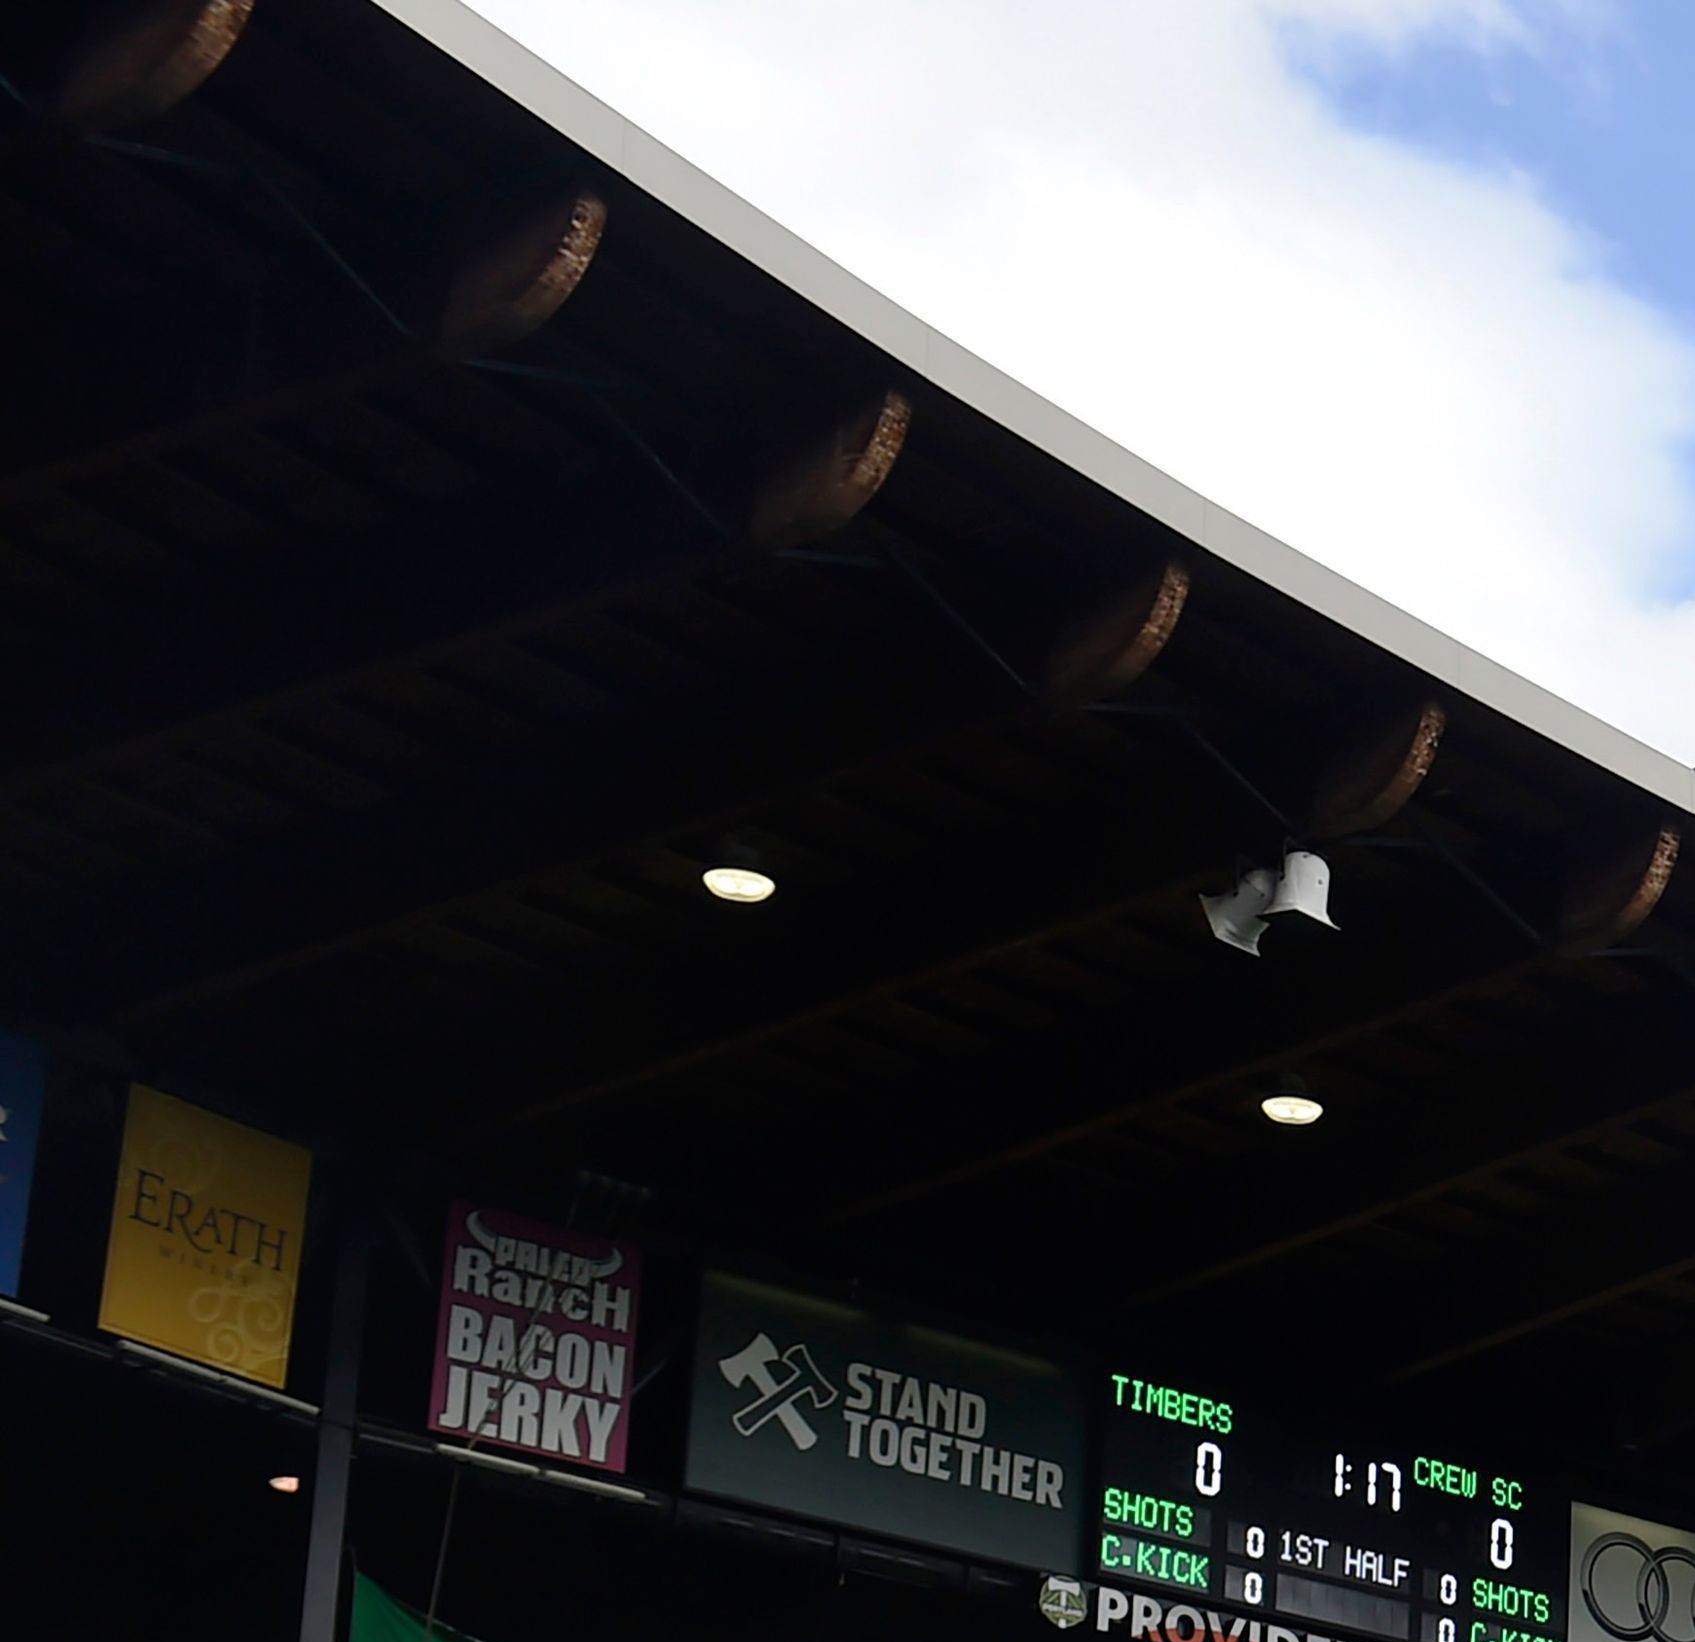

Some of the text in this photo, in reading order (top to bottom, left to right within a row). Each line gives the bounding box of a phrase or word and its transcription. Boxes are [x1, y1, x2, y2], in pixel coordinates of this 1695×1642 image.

[128, 1169, 288, 1271] ERATH
[446, 1303, 627, 1399] BACON
[438, 1365, 621, 1463] JERKY
[844, 1362, 987, 1439] STAND
[1112, 1374, 1233, 1434] TIMBERS
[843, 1409, 1064, 1509] TOGETHER
[1195, 1442, 1222, 1497] 0
[1413, 1456, 1523, 1511] CREW SC
[1103, 1487, 1194, 1538] SHOTS
[1246, 1526, 1266, 1560] 0
[1279, 1531, 1411, 1588] 1ST HALF
[1490, 1518, 1515, 1571] 0
[1243, 1572, 1263, 1606] 0
[1439, 1574, 1458, 1607] 0
[1472, 1580, 1551, 1624] SHOTS
